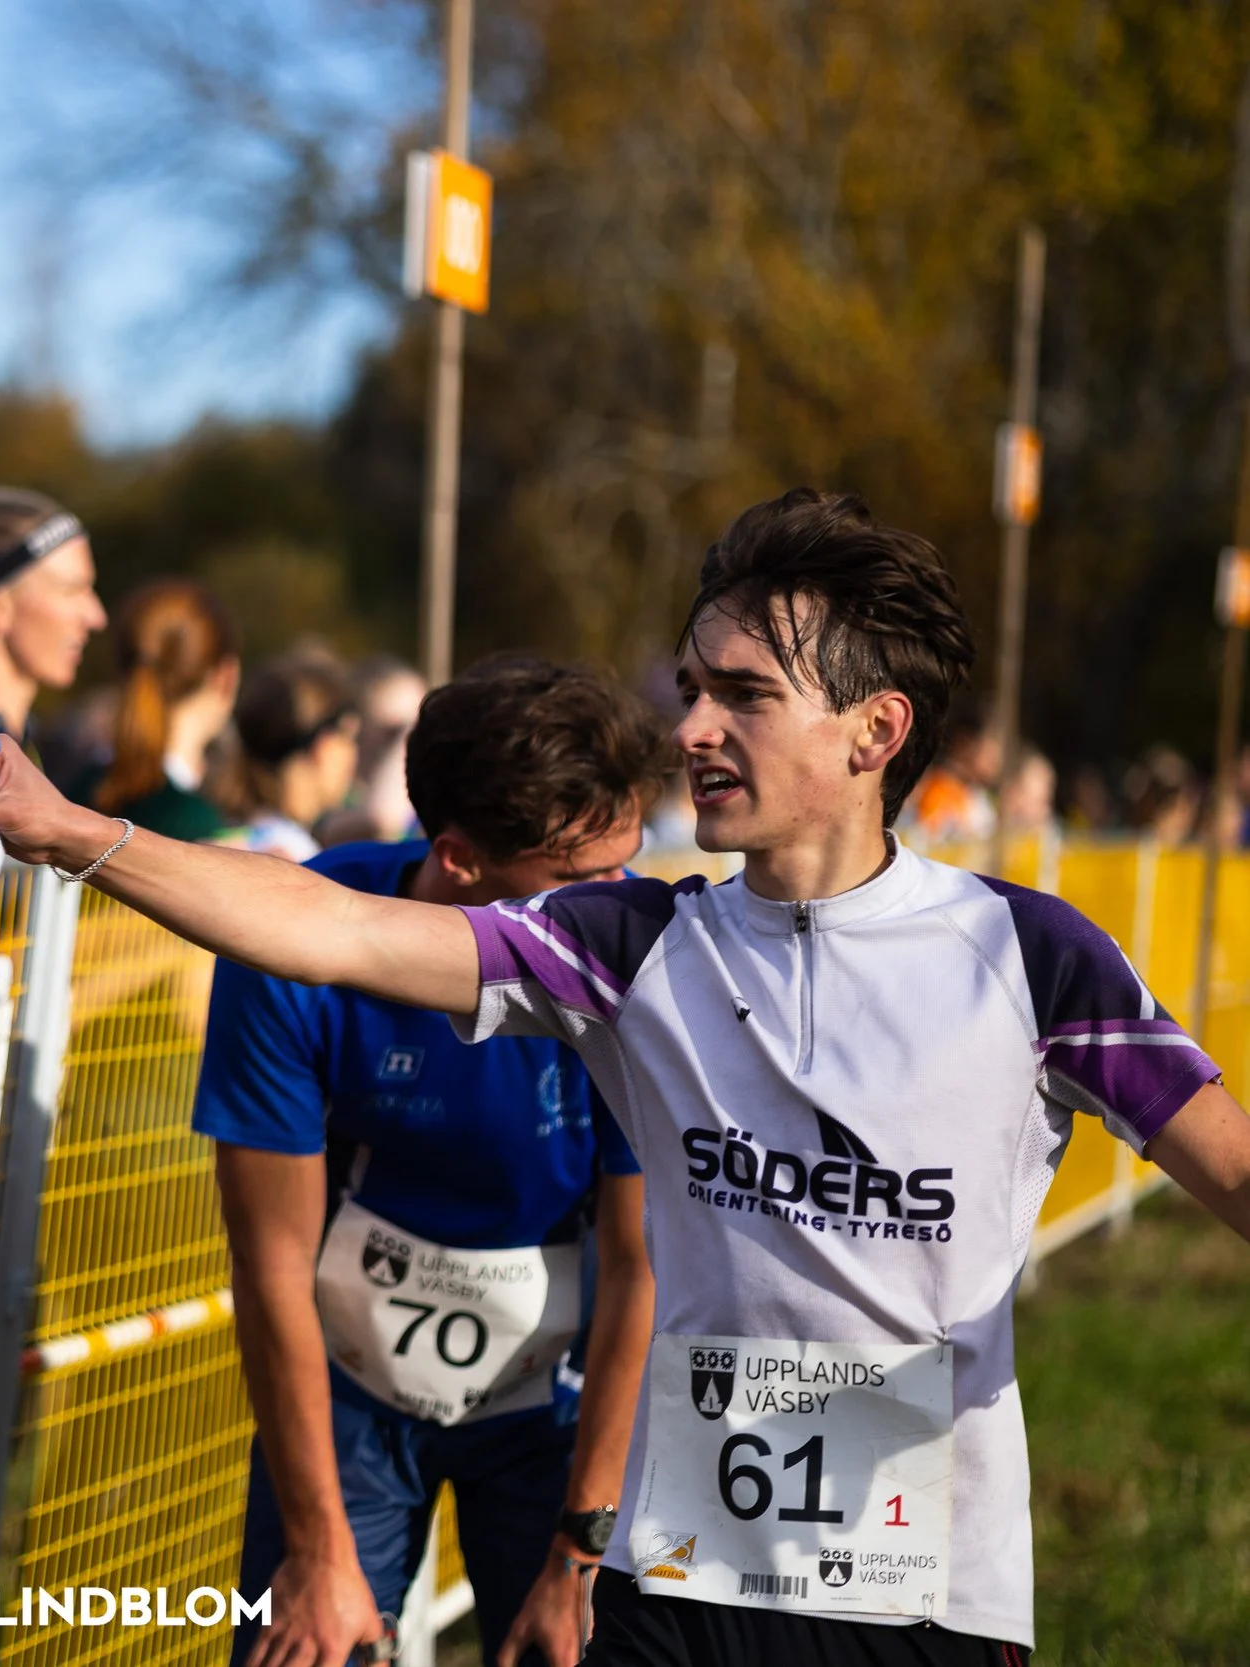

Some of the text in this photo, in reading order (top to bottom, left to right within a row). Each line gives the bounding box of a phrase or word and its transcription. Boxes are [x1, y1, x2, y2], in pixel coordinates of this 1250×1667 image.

[682, 1127, 955, 1221] SÖDERS
[419, 1253, 534, 1283] UPPLANDS
[387, 1296, 490, 1369] 70
[745, 1356, 885, 1387] UPPLANDS
[745, 1386, 830, 1414] VÄSBY
[718, 1432, 843, 1524] 61
[885, 1494, 910, 1526] 1
[859, 1553, 937, 1569] UPPLANDS
[859, 1570, 907, 1584] VÄSBY
